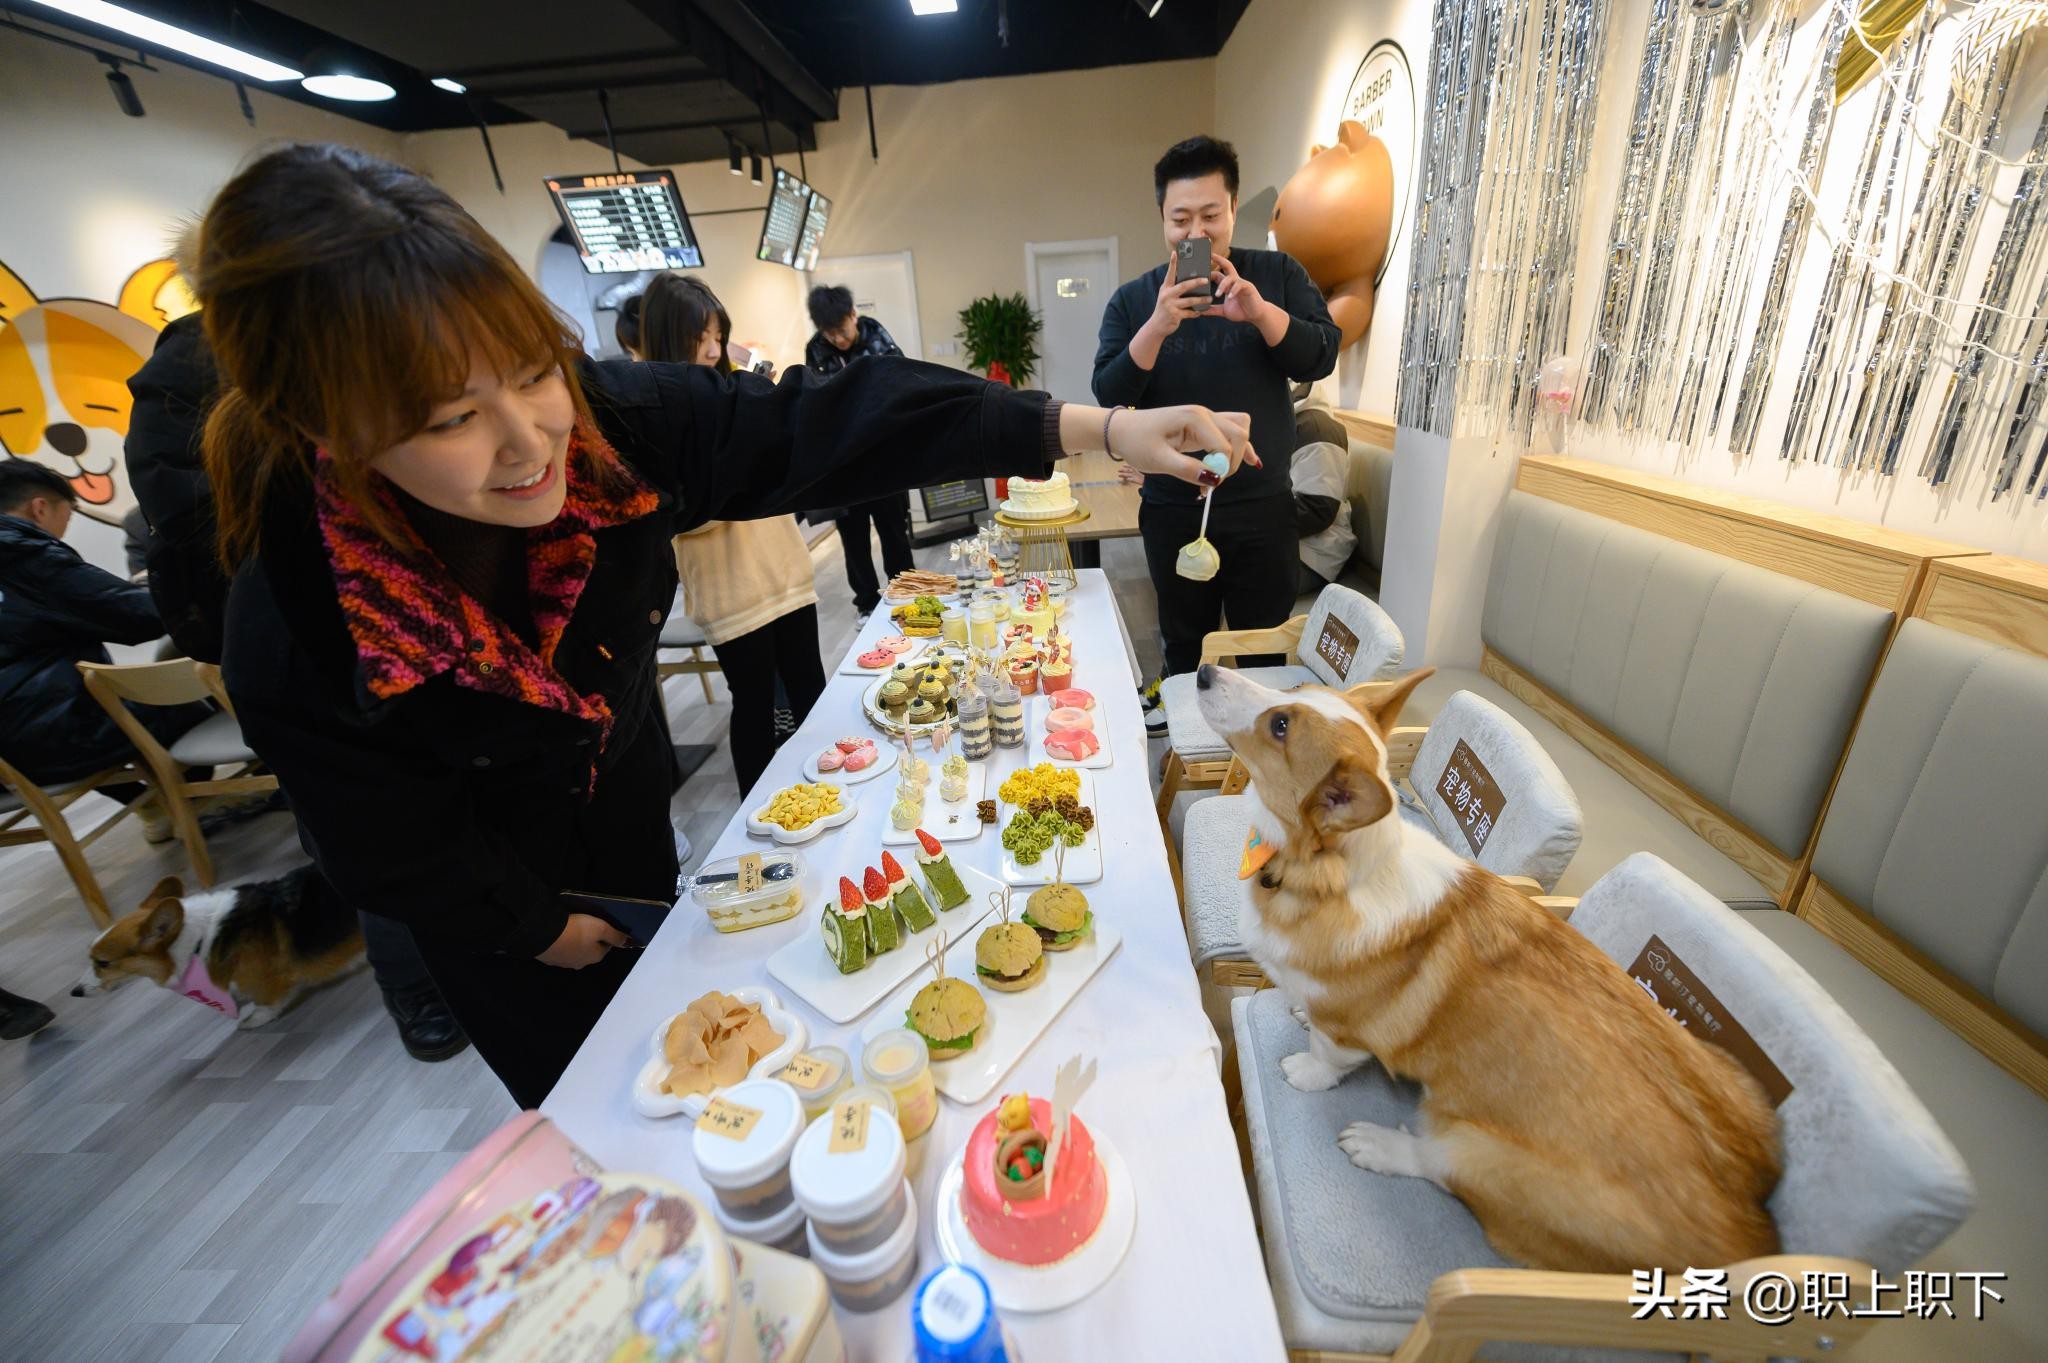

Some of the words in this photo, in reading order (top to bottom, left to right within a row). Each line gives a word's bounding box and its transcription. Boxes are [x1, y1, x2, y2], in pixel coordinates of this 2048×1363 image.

[1320, 632, 1352, 674] 宠物专座
[1443, 767, 1492, 846] 宠物专座
